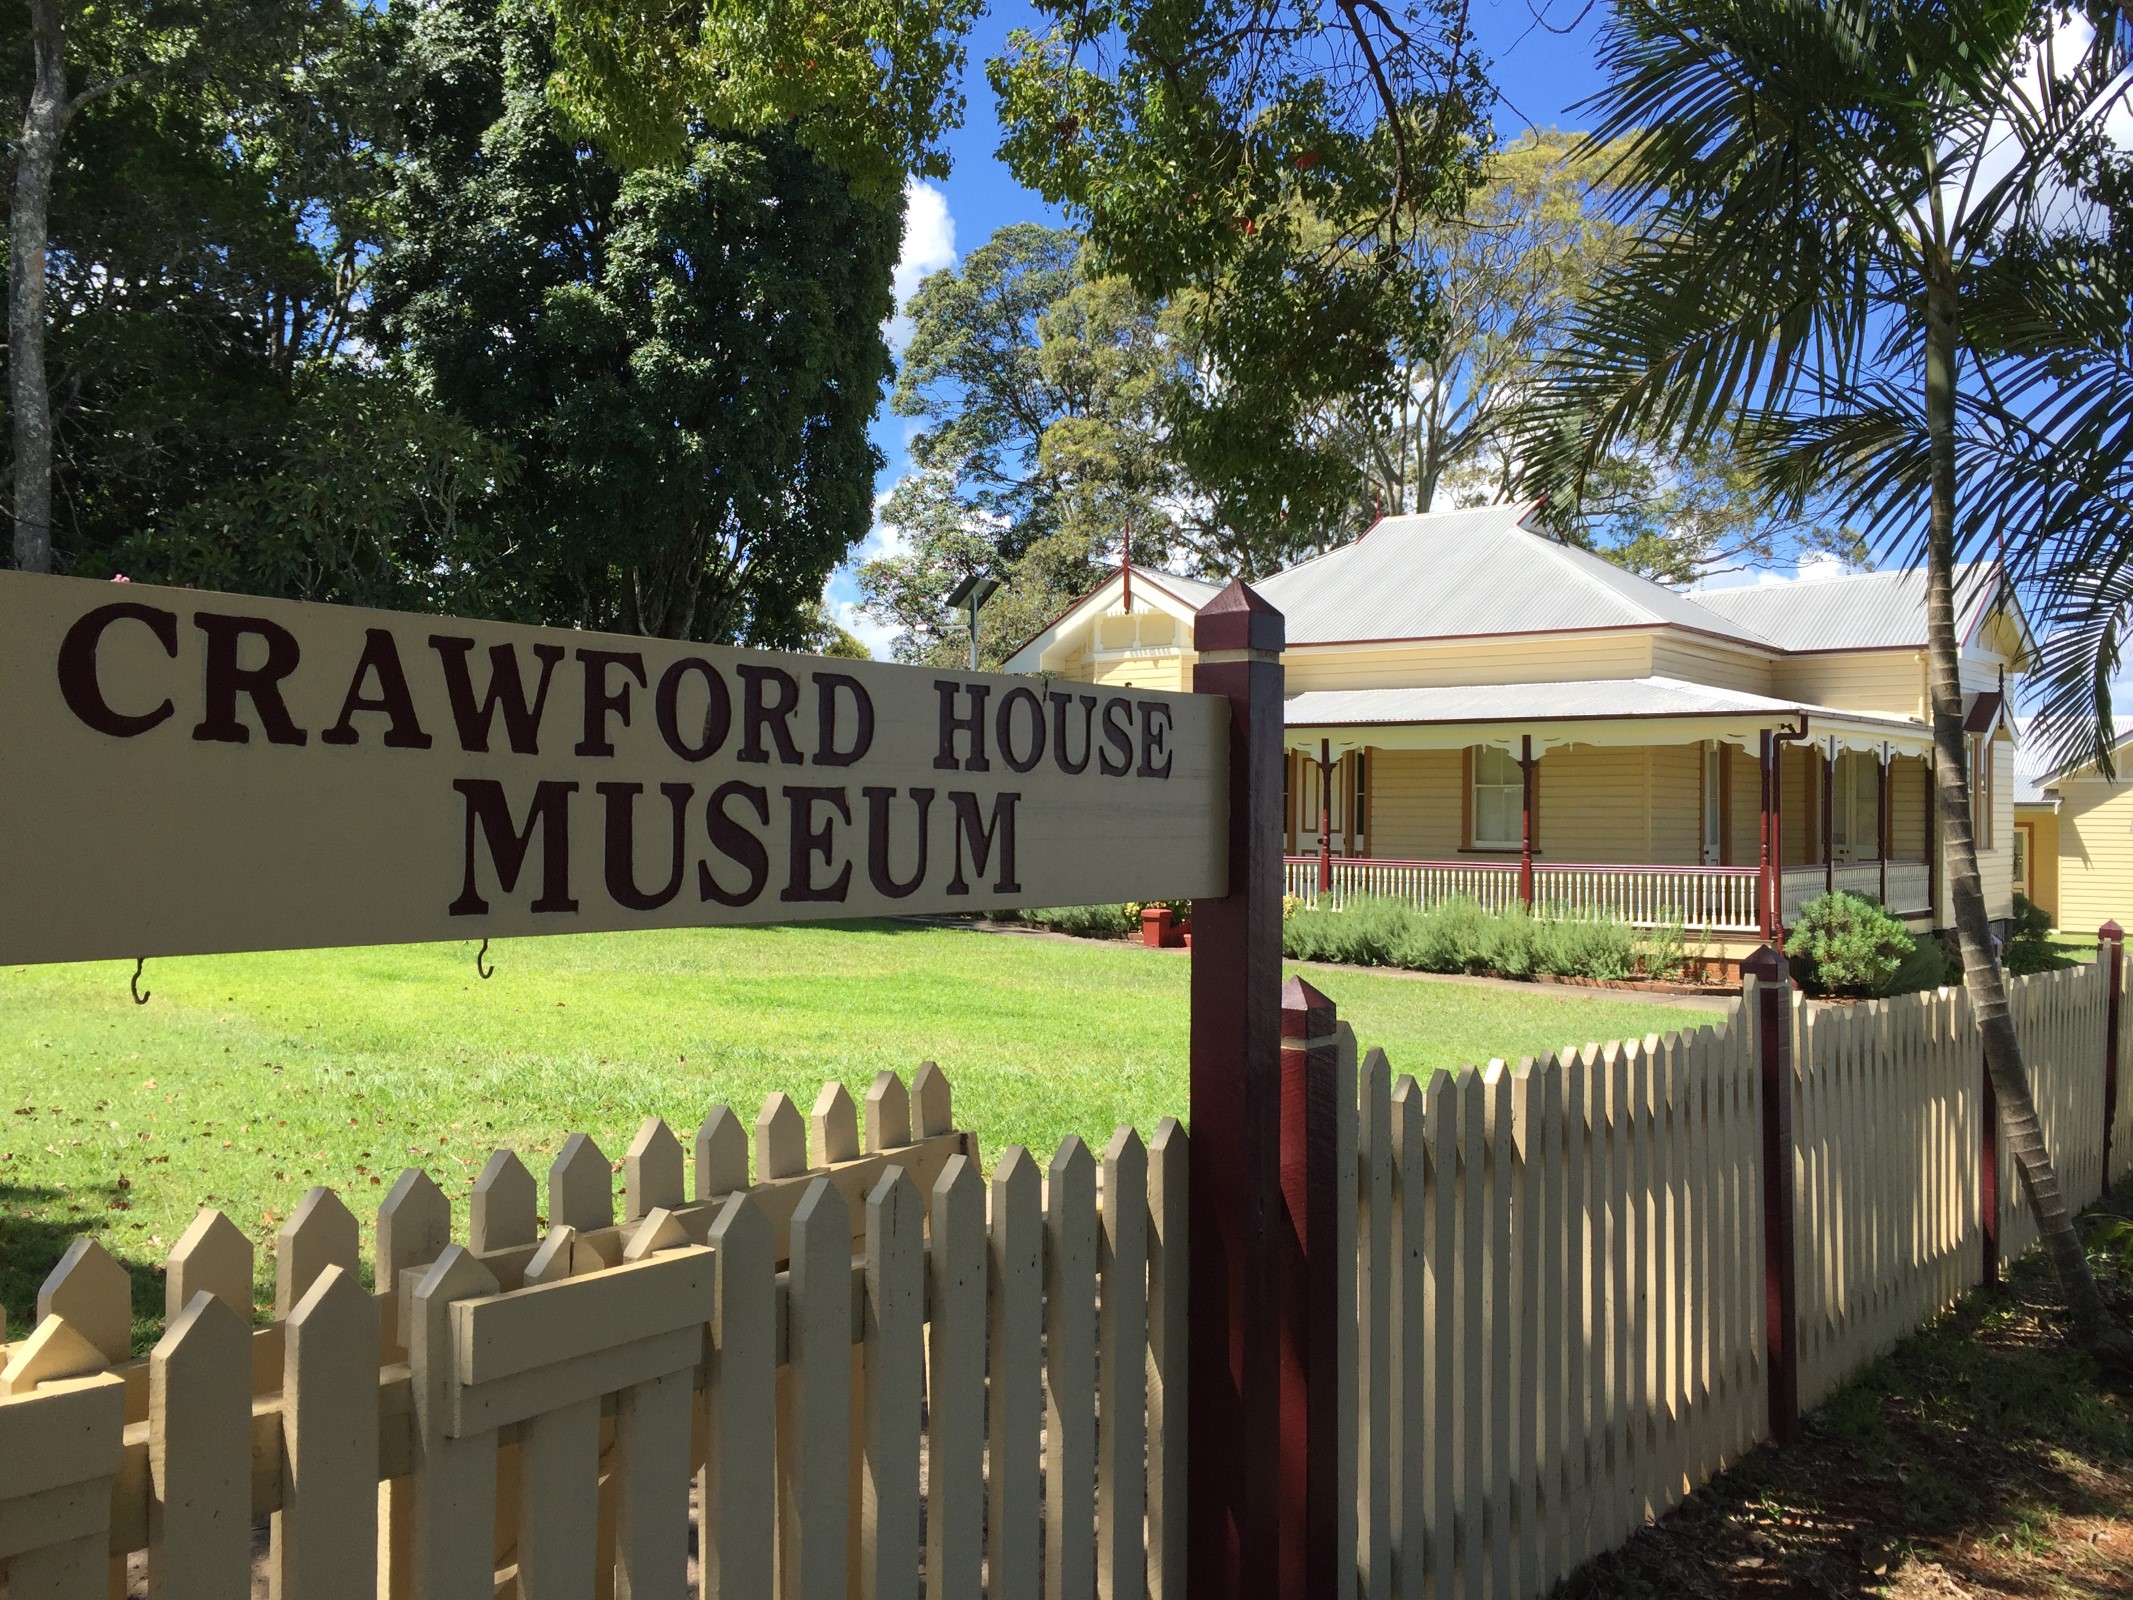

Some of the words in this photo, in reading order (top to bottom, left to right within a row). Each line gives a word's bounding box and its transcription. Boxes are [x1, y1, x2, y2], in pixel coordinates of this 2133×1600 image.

[58, 602, 874, 766] CRAWFORD
[933, 680, 1173, 779] HOUSE
[449, 779, 1021, 916] MUSEUM
